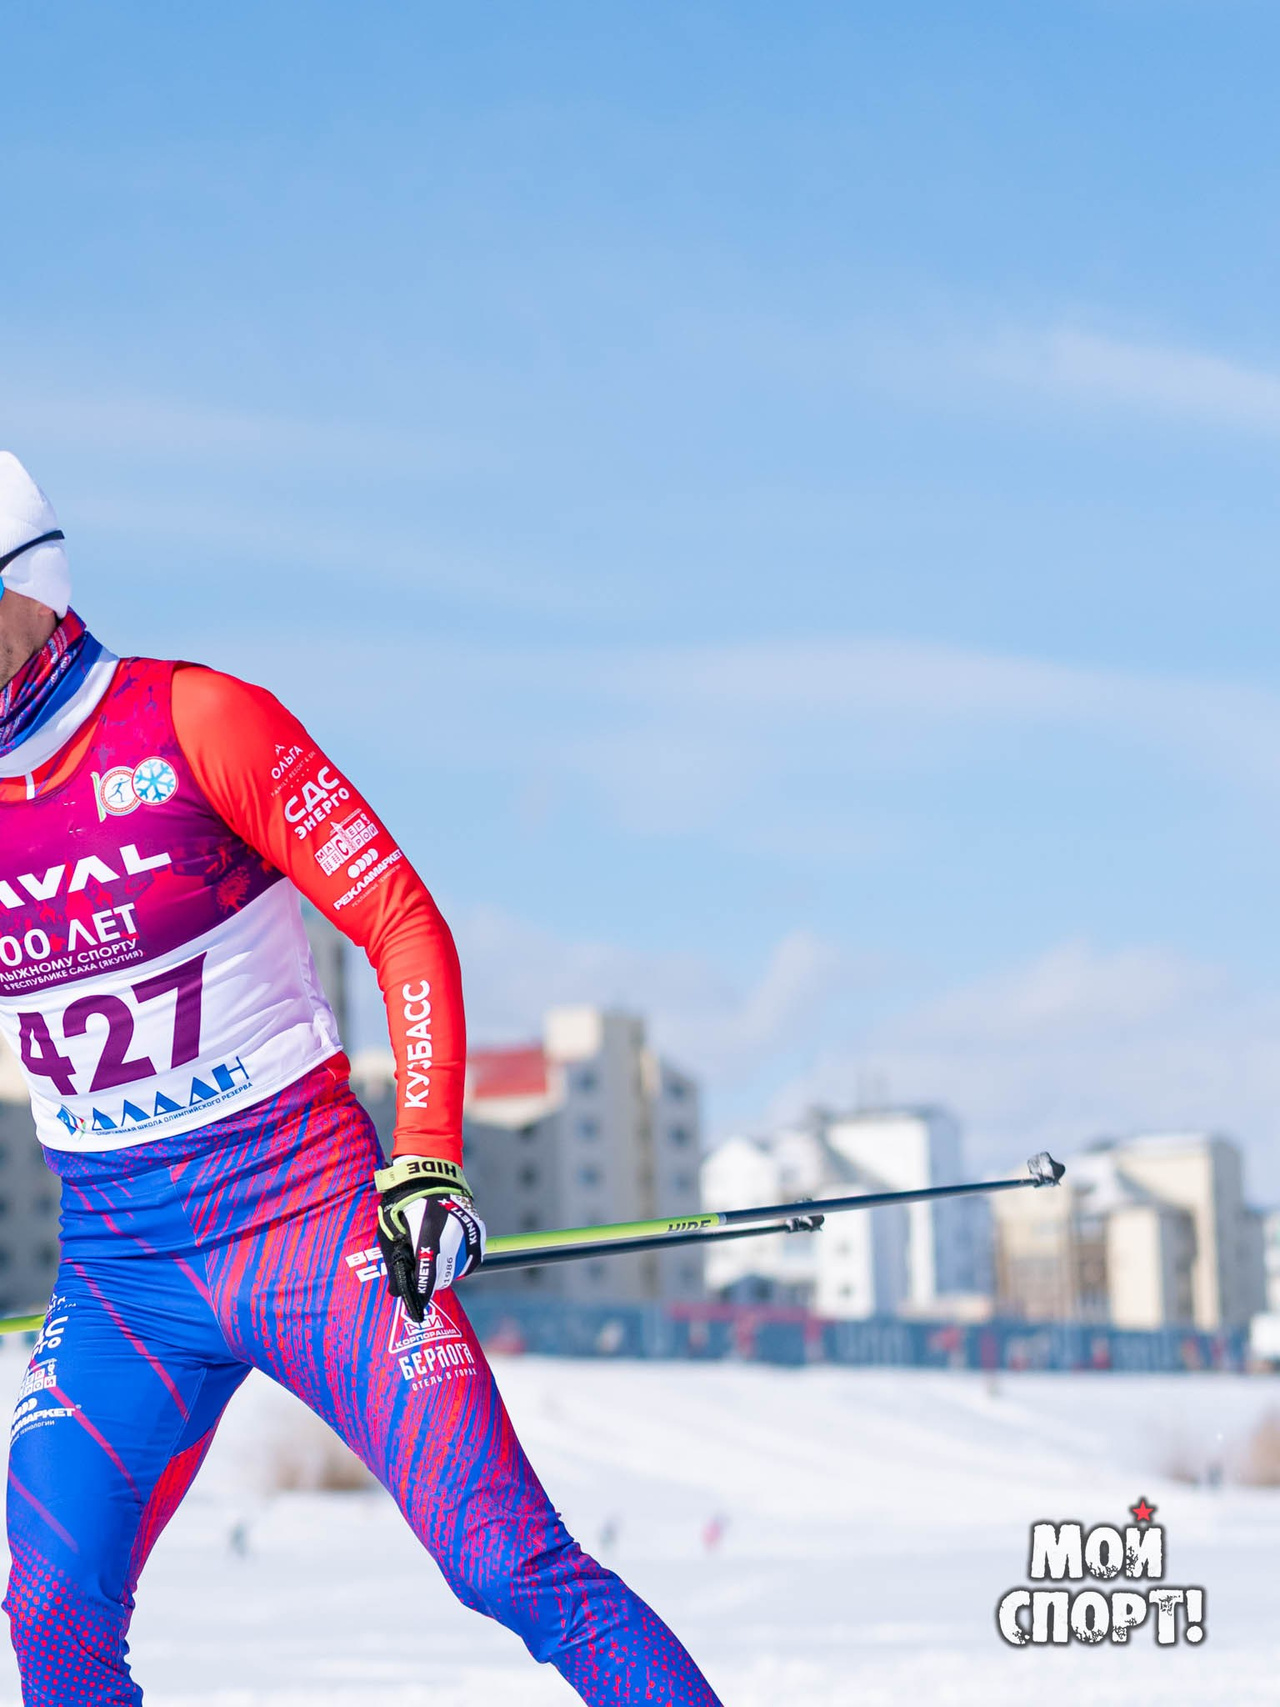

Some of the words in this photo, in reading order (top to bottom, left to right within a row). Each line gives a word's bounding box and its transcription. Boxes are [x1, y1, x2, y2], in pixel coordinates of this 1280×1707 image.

[271, 745, 303, 779] ОЛЬГА
[284, 766, 341, 823] СДС
[294, 787, 350, 840] ЭНЕРГО
[68, 902, 137, 952] ЛЕТ
[0, 956, 73, 983] ЛЫЖНОМУ
[77, 938, 137, 964] СПОРТУ
[11, 970, 68, 990] РЕСПУБЛИКЕ
[69, 962, 98, 975] САХА
[98, 949, 144, 969] (ЯКУТИЯ)
[18, 951, 207, 1096] 427
[137, 1119, 163, 1130] ШКОЛА
[163, 1097, 221, 1123] ОЛИМПИЙСКОГО
[221, 1081, 253, 1102] РЕЗЕРВА
[406, 1160, 458, 1178] HIDE
[395, 1328, 457, 1349] КОРПОРАЦИЯ
[398, 1342, 475, 1381] БЕРЛОГА
[411, 1374, 443, 1391] ОТЕЛЬ
[445, 1371, 452, 1380] В
